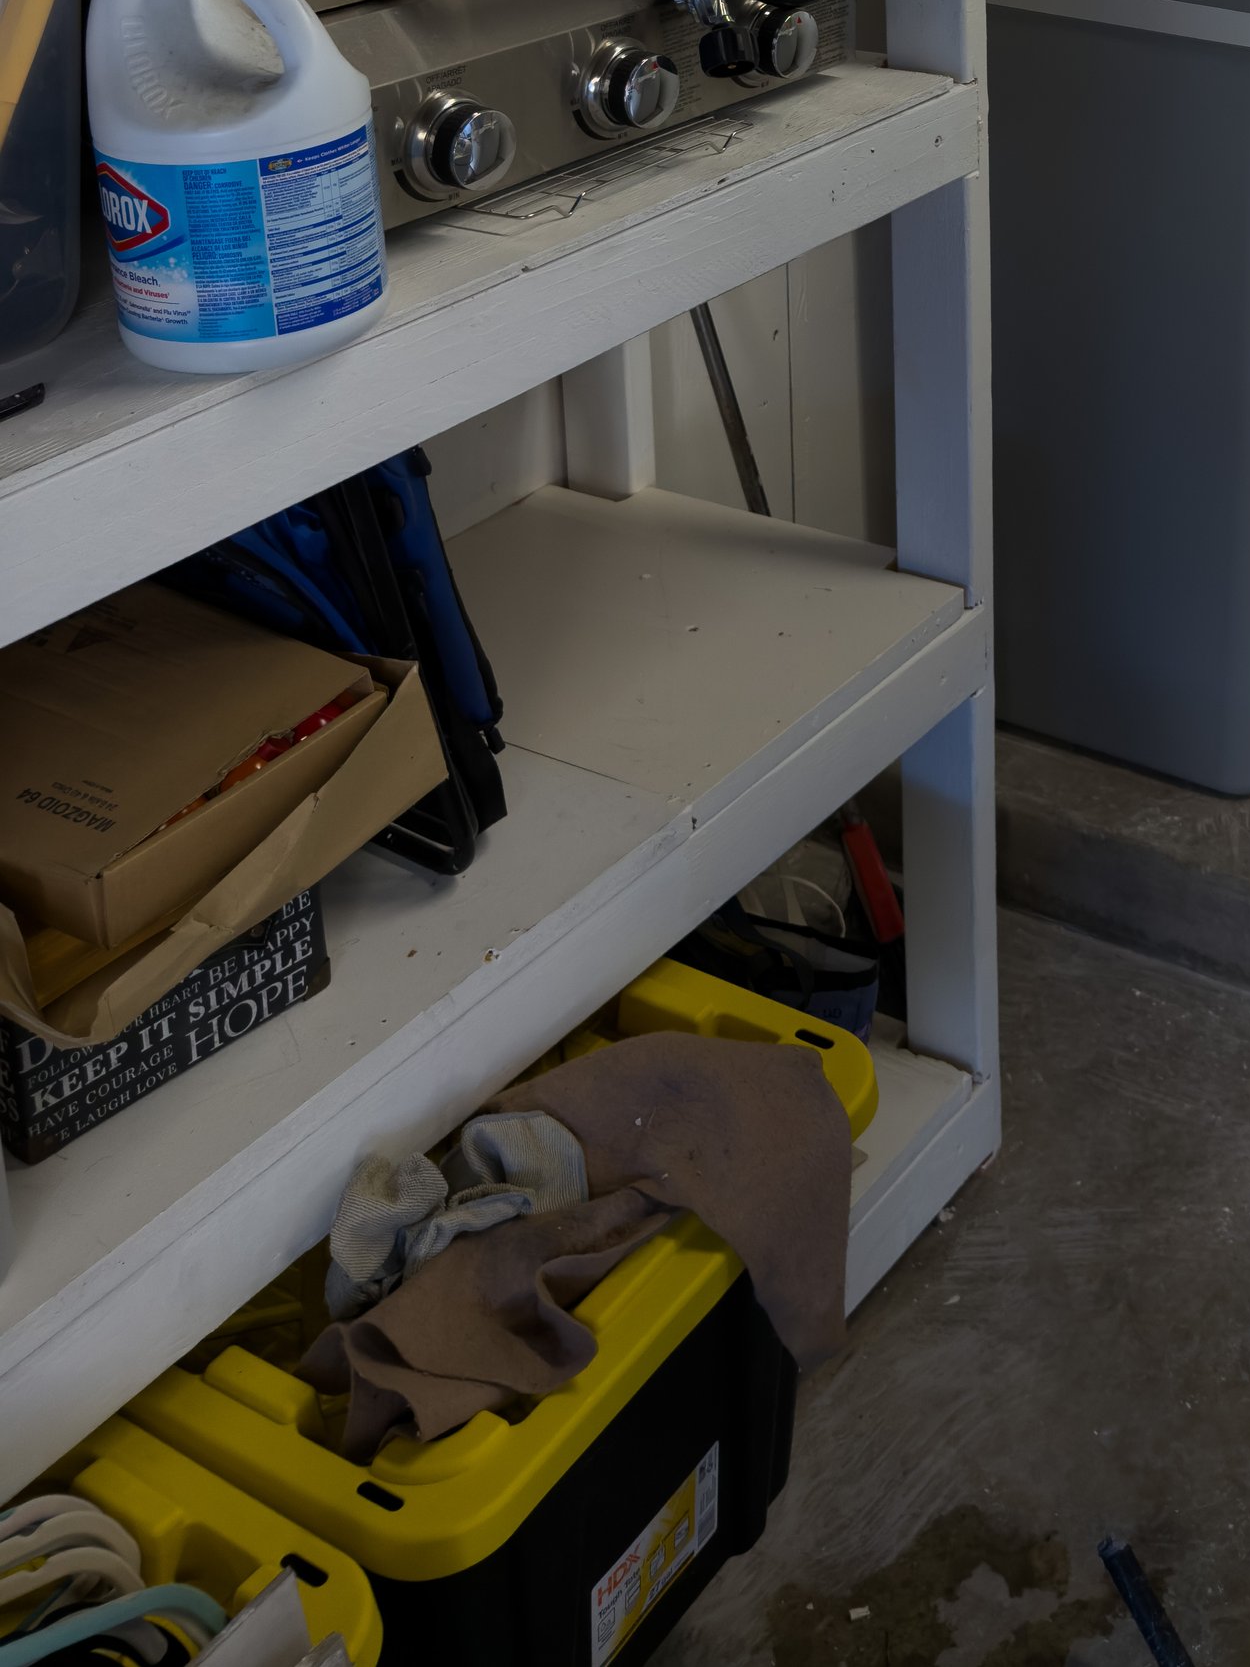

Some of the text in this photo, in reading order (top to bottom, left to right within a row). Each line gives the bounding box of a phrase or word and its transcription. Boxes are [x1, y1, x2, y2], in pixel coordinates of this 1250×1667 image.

[427, 77, 462, 93] APAGADO
[184, 182, 213, 190] DANGER:
[16, 788, 116, 832] MAGZOID 64
[209, 911, 315, 985] BE HAPPY
[27, 1045, 95, 1089] FOLLOW
[150, 981, 201, 1018] HEART
[30, 1041, 128, 1116] KEEP
[139, 1013, 177, 1053] IT
[188, 936, 313, 1024] SIMPLE
[185, 965, 309, 1065] HOPE
[27, 1101, 79, 1137] HAVE
[85, 1044, 174, 1105] COURAGE
[76, 1062, 177, 1131] LAUGH LOVE
[598, 1543, 640, 1606] HDX
